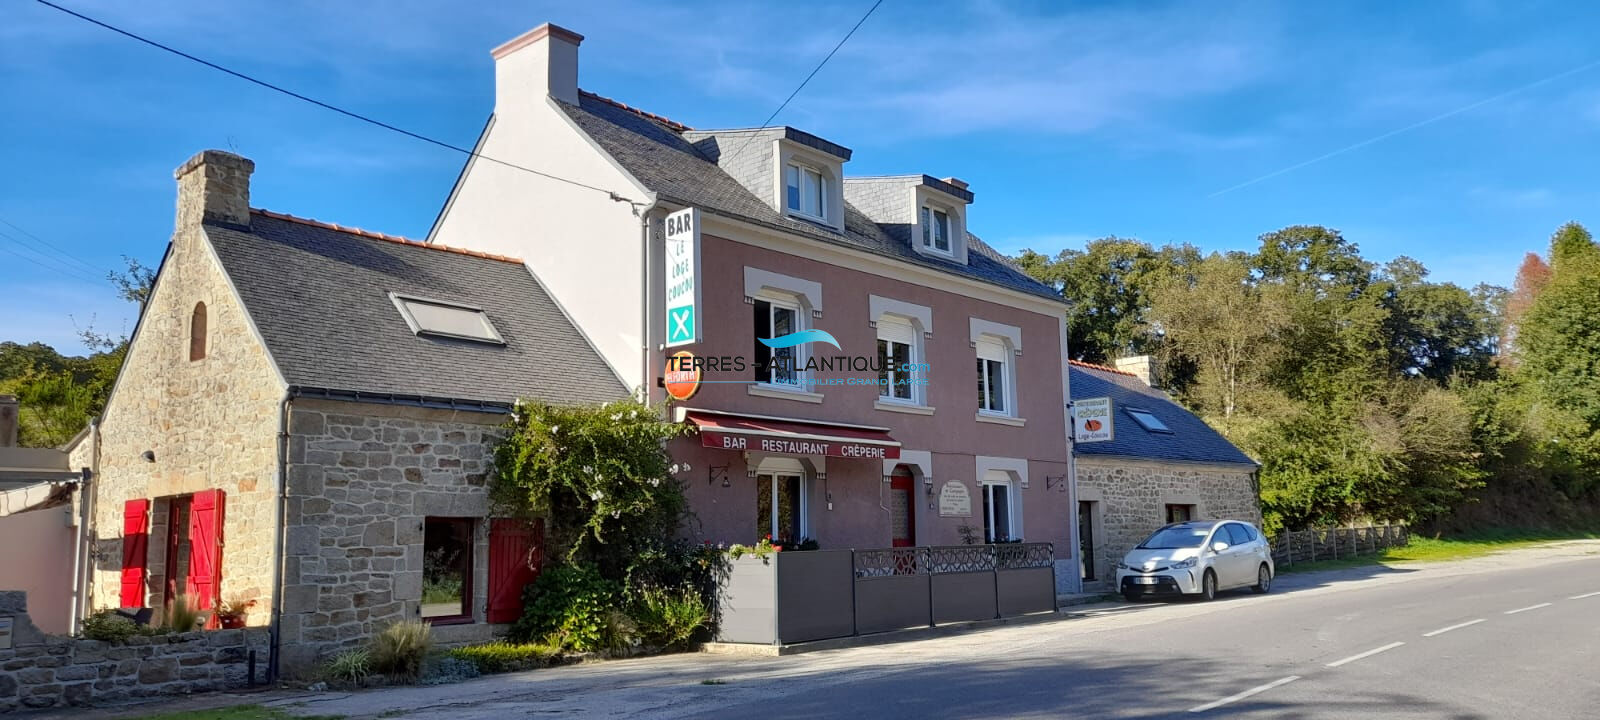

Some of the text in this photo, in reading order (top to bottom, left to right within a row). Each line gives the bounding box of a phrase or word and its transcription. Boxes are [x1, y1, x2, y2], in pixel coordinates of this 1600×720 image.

[667, 213, 692, 237] BAR
[676, 240, 685, 256] LE
[672, 258, 689, 279] LOGE
[668, 276, 693, 302] COUCOU
[723, 436, 886, 459] BAR RESTAURANT CRÊPERIE
